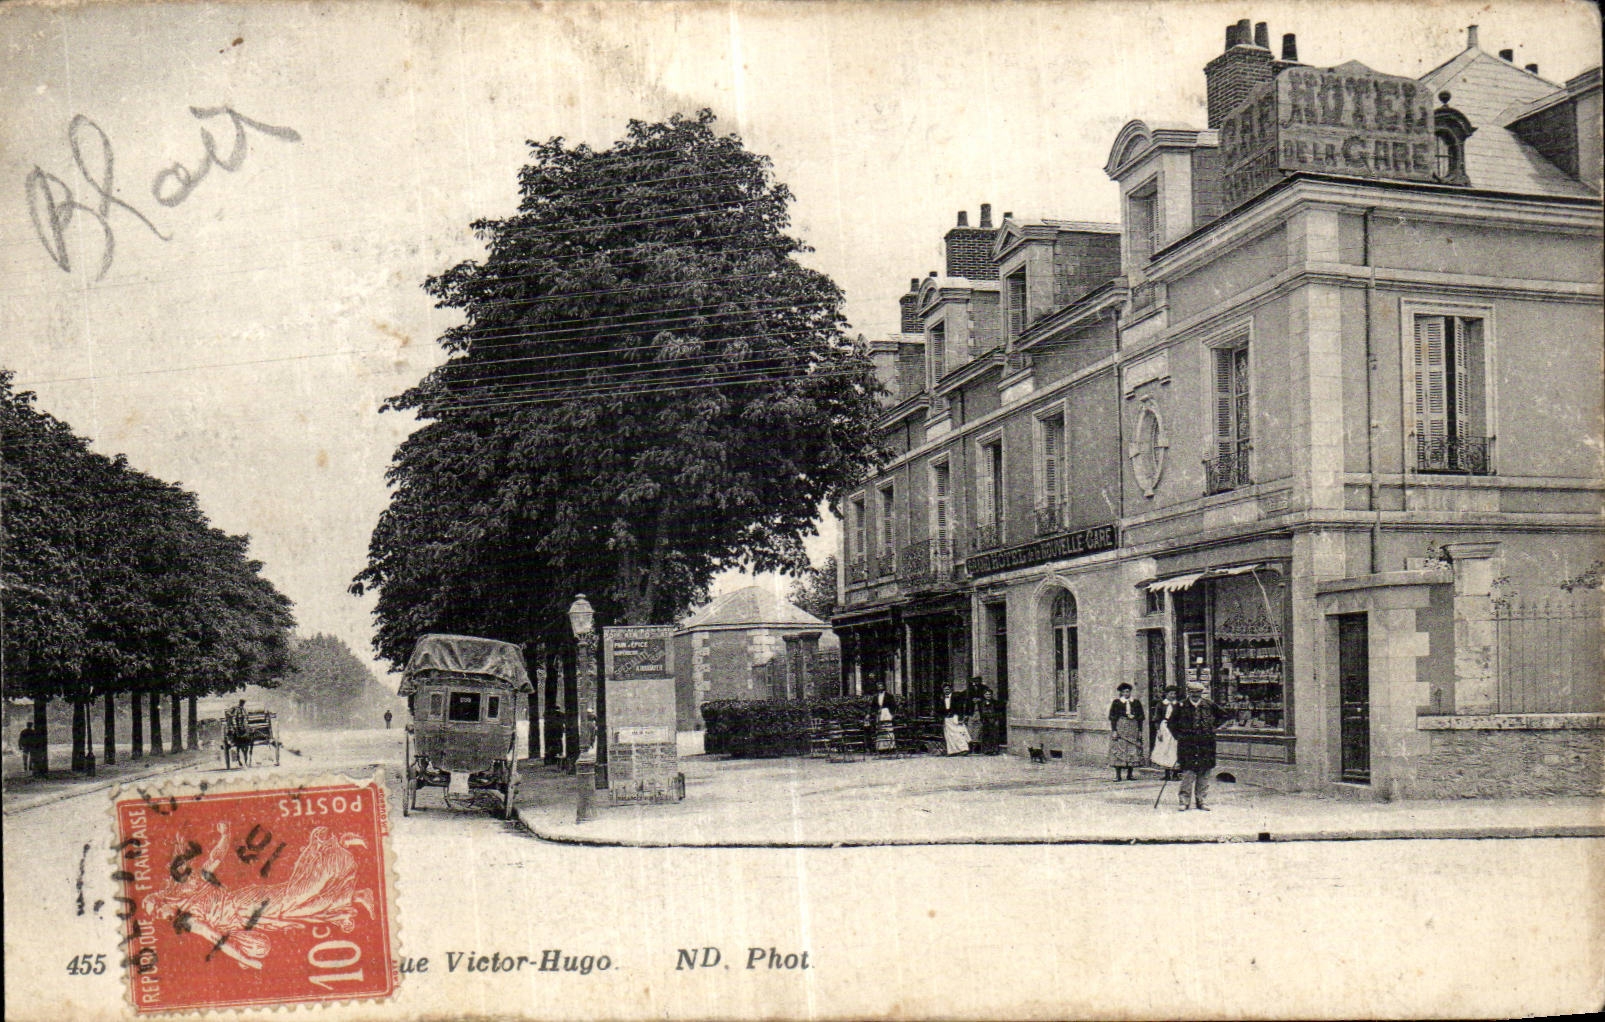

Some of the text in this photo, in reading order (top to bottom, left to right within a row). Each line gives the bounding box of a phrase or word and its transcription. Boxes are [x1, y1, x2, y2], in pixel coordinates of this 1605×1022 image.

[1341, 135, 1430, 174] GARE
[1085, 526, 1113, 549] GARE
[281, 796, 363, 817] POSTES
[127, 807, 153, 892] FRANÇAISE
